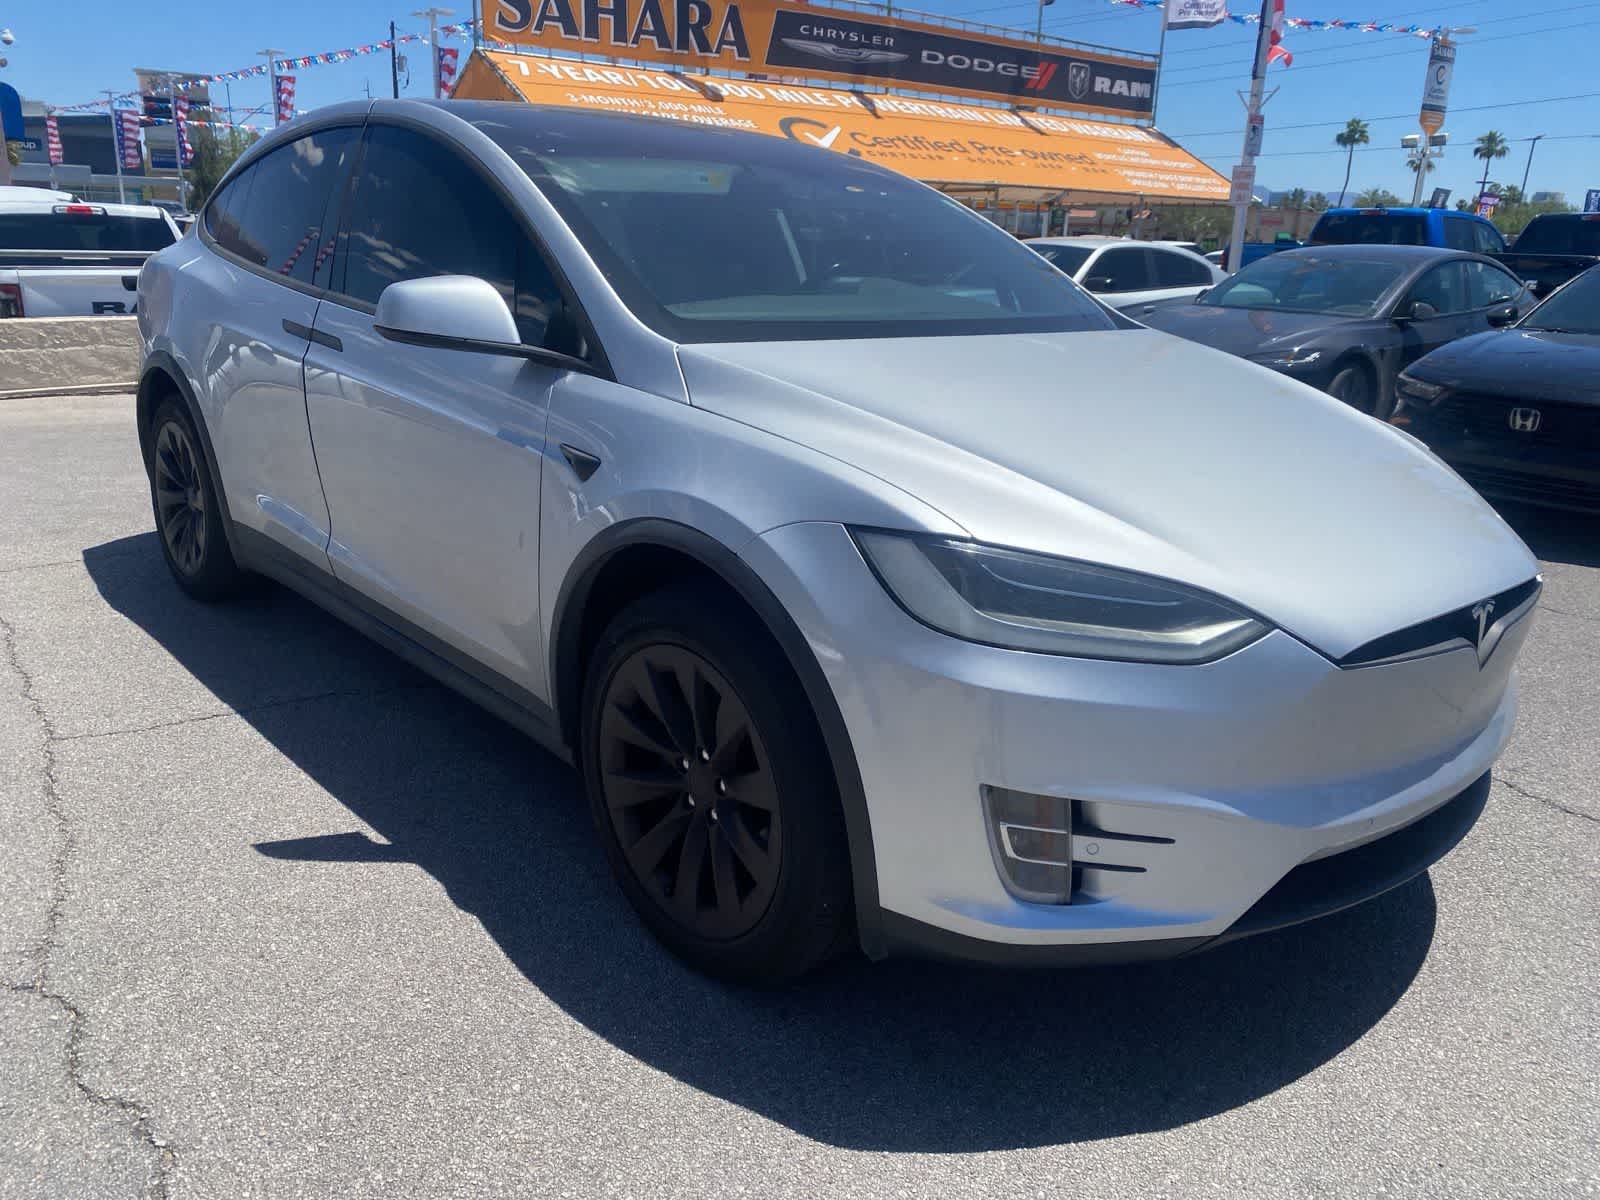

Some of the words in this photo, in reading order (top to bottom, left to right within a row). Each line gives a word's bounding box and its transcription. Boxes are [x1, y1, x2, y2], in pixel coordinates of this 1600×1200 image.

[495, 0, 751, 61] SAHARA
[800, 25, 894, 47] CHRYSLER
[921, 50, 1040, 79] DODGE
[507, 59, 766, 100] 7-YEAR/100000
[766, 87, 837, 107] MILE
[1094, 77, 1151, 98] RAM
[850, 131, 969, 154] Certified
